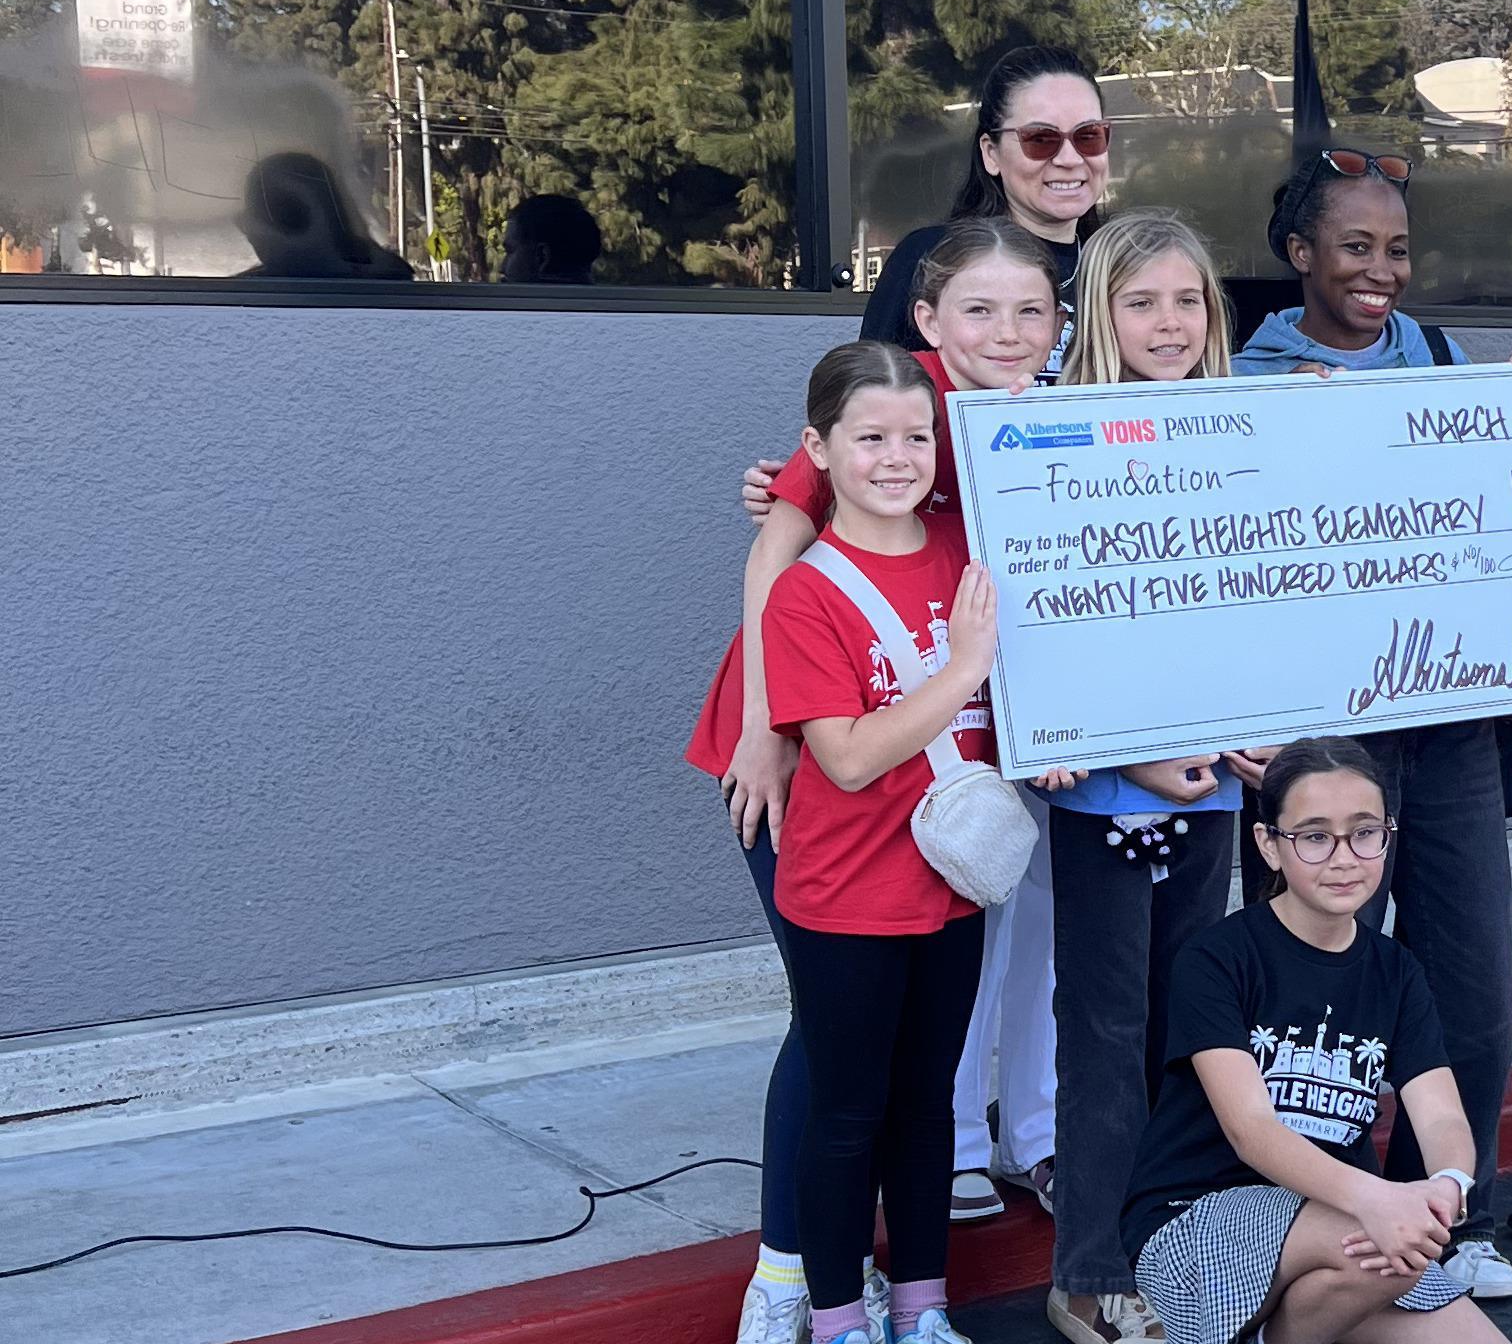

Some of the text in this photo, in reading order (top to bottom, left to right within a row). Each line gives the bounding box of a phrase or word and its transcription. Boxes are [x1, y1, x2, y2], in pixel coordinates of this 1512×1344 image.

[1025, 413, 1255, 445] Albertsons VONS PAVILIONS
[1406, 405, 1511, 444] MARCH
[1046, 459, 1222, 503] Foundation
[1005, 532, 1081, 555] Pay to the
[1081, 494, 1484, 565] CASTLE HEIGHTS ELEMENTARY
[1008, 554, 1070, 575] order of
[1025, 576, 1136, 620] TWENTY
[1143, 572, 1209, 610] FIVE
[1218, 562, 1335, 601] HUNDRED
[1343, 552, 1448, 590] DOLLARS
[1032, 727, 1084, 746] Memo:
[1266, 1080, 1378, 1125] TLE HEIGHTS
[1282, 1117, 1338, 1136] EMENTARY
